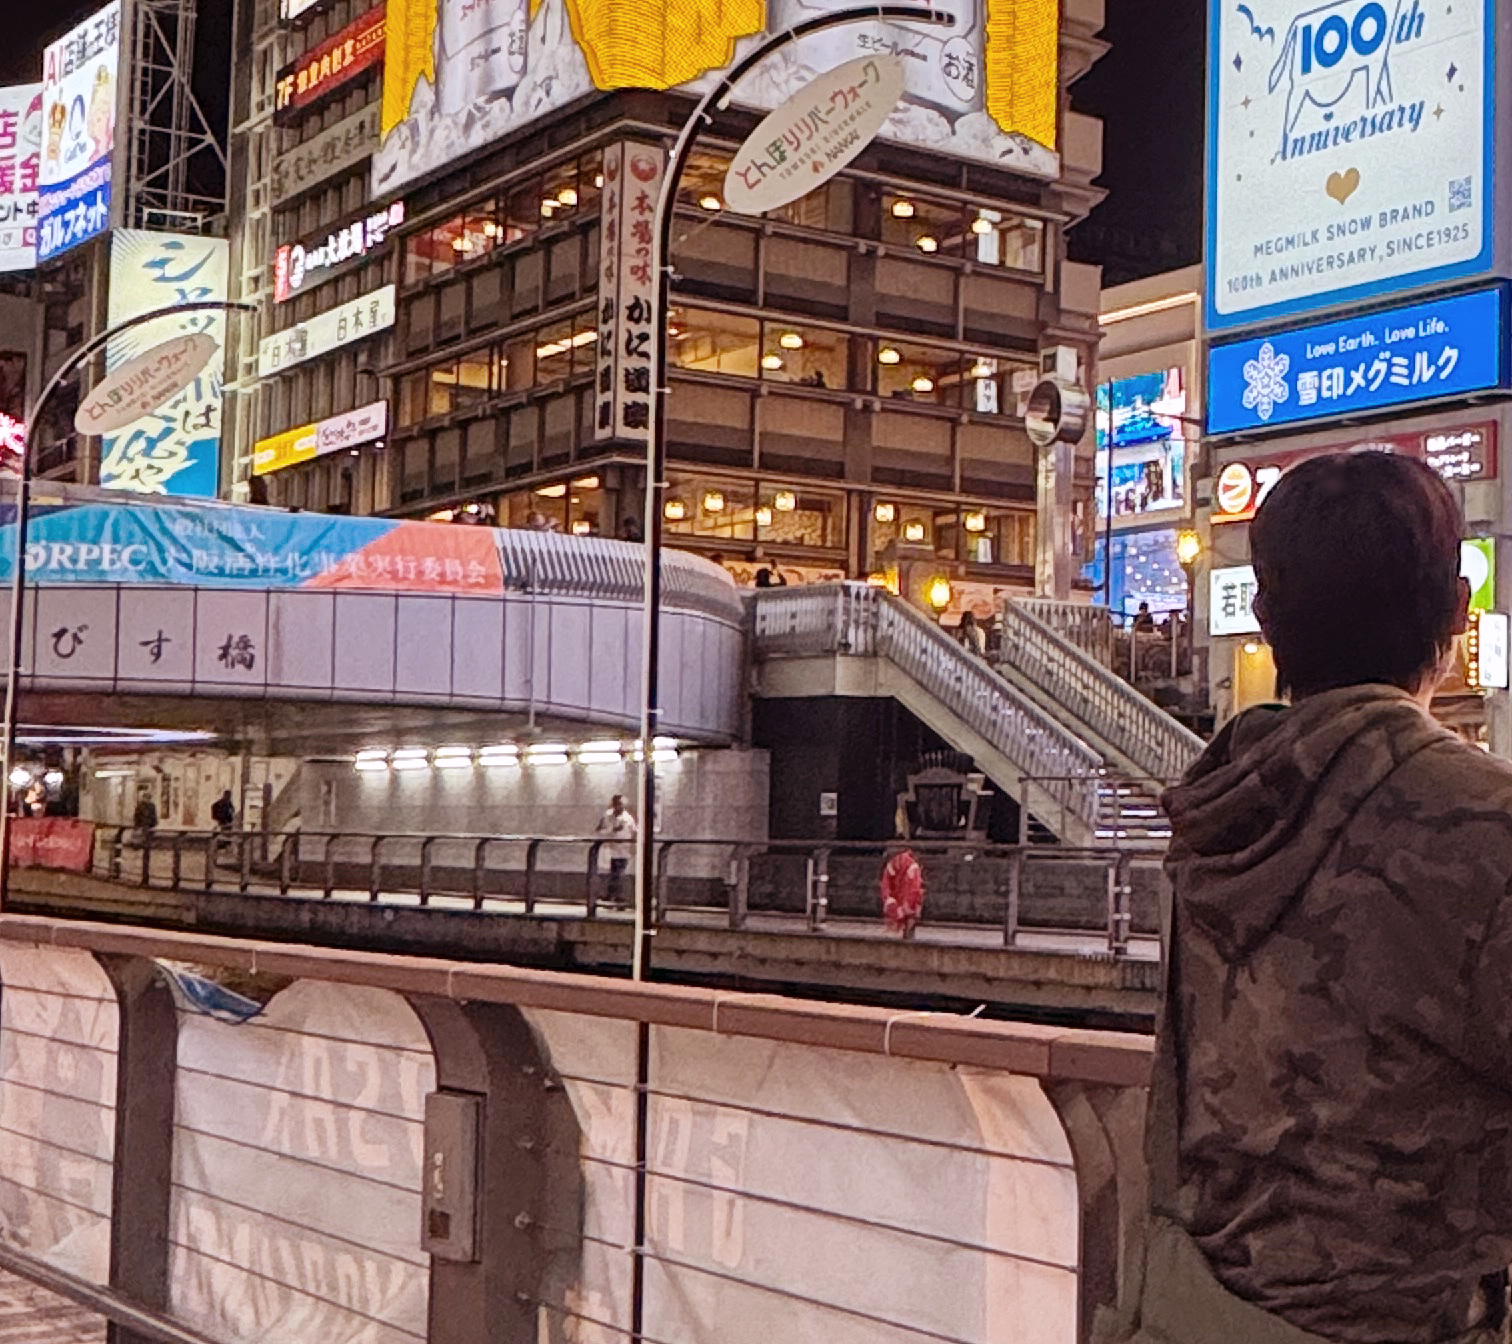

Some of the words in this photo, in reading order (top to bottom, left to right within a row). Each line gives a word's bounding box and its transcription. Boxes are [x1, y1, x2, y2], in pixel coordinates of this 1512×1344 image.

[1253, 225, 1321, 259] MEGMILK
[1326, 214, 1374, 242] SNOW
[1378, 200, 1436, 229] BRAND
[1305, 342, 1336, 360] Love
[1338, 332, 1380, 353] Earth.
[1384, 325, 1417, 344] Love
[1418, 316, 1450, 337] Life.
[1296, 344, 1460, 406] 雪印メグミルク
